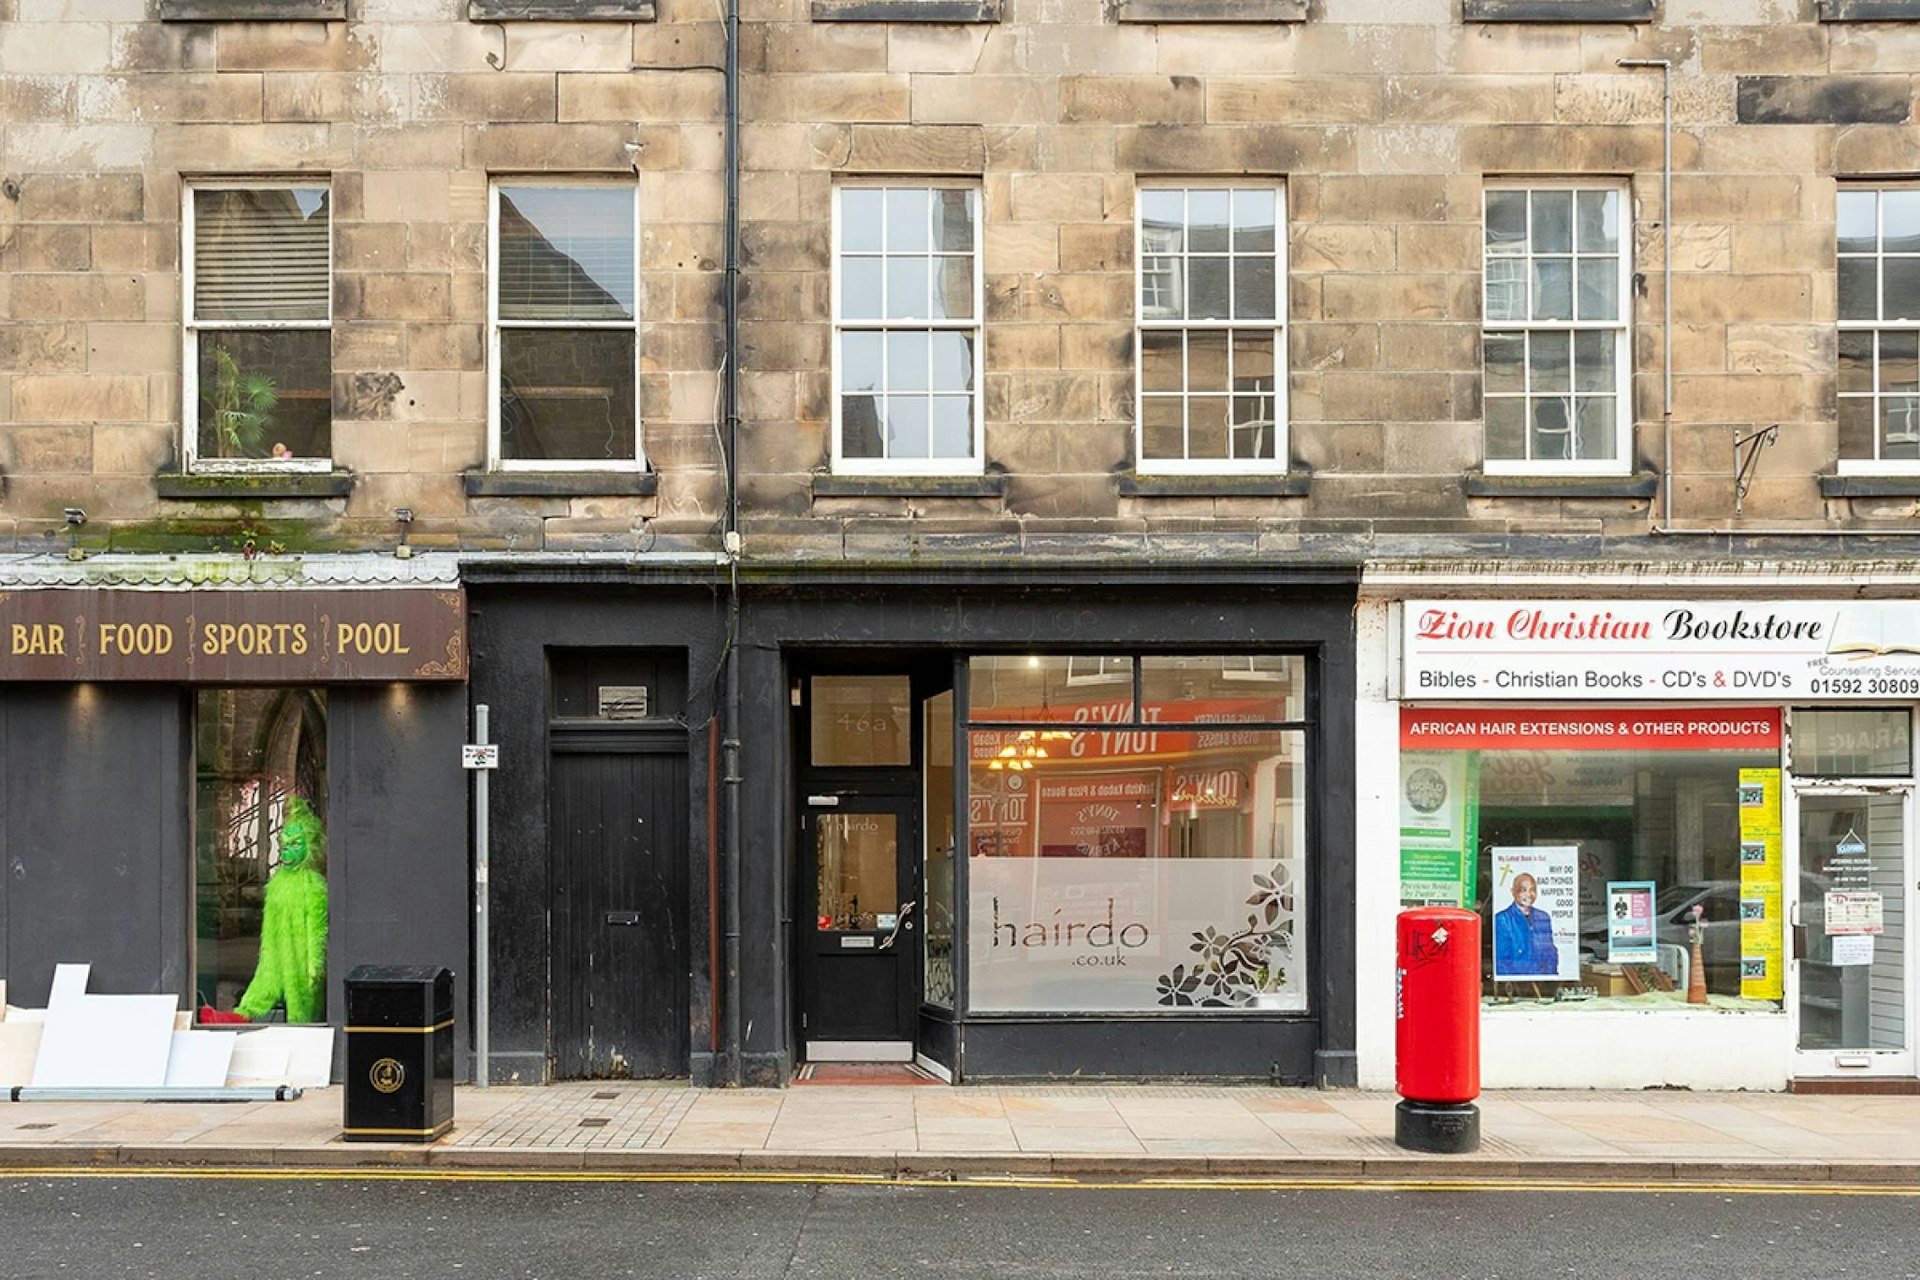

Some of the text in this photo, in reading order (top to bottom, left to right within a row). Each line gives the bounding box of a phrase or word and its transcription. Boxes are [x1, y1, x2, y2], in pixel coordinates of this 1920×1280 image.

[1416, 608, 1823, 641] Zion Christian Bookstore
[12, 623, 409, 655] BAR FOOD SPORTS POOL
[1420, 670, 1476, 688] Bibles
[1495, 670, 1578, 688] Christian
[1585, 670, 1643, 688] Books
[1662, 670, 1707, 688] CD's
[1713, 671, 1726, 687] &
[1733, 670, 1792, 688] DVD's
[1810, 678, 1862, 694] 01592
[837, 704, 887, 732] 46a
[1409, 721, 1770, 736] AFRICAN HAIR EXTENSIONS & OTHER PRODUCTS
[1549, 865, 1574, 874] WHY DO
[1550, 877, 1574, 885] THINGS
[1540, 888, 1564, 896] HAPPEN
[1556, 899, 1574, 907] GOOD
[992, 896, 1149, 948] hairdo
[1551, 910, 1574, 918] PEOPLE
[1071, 946, 1127, 967] .co.uk
